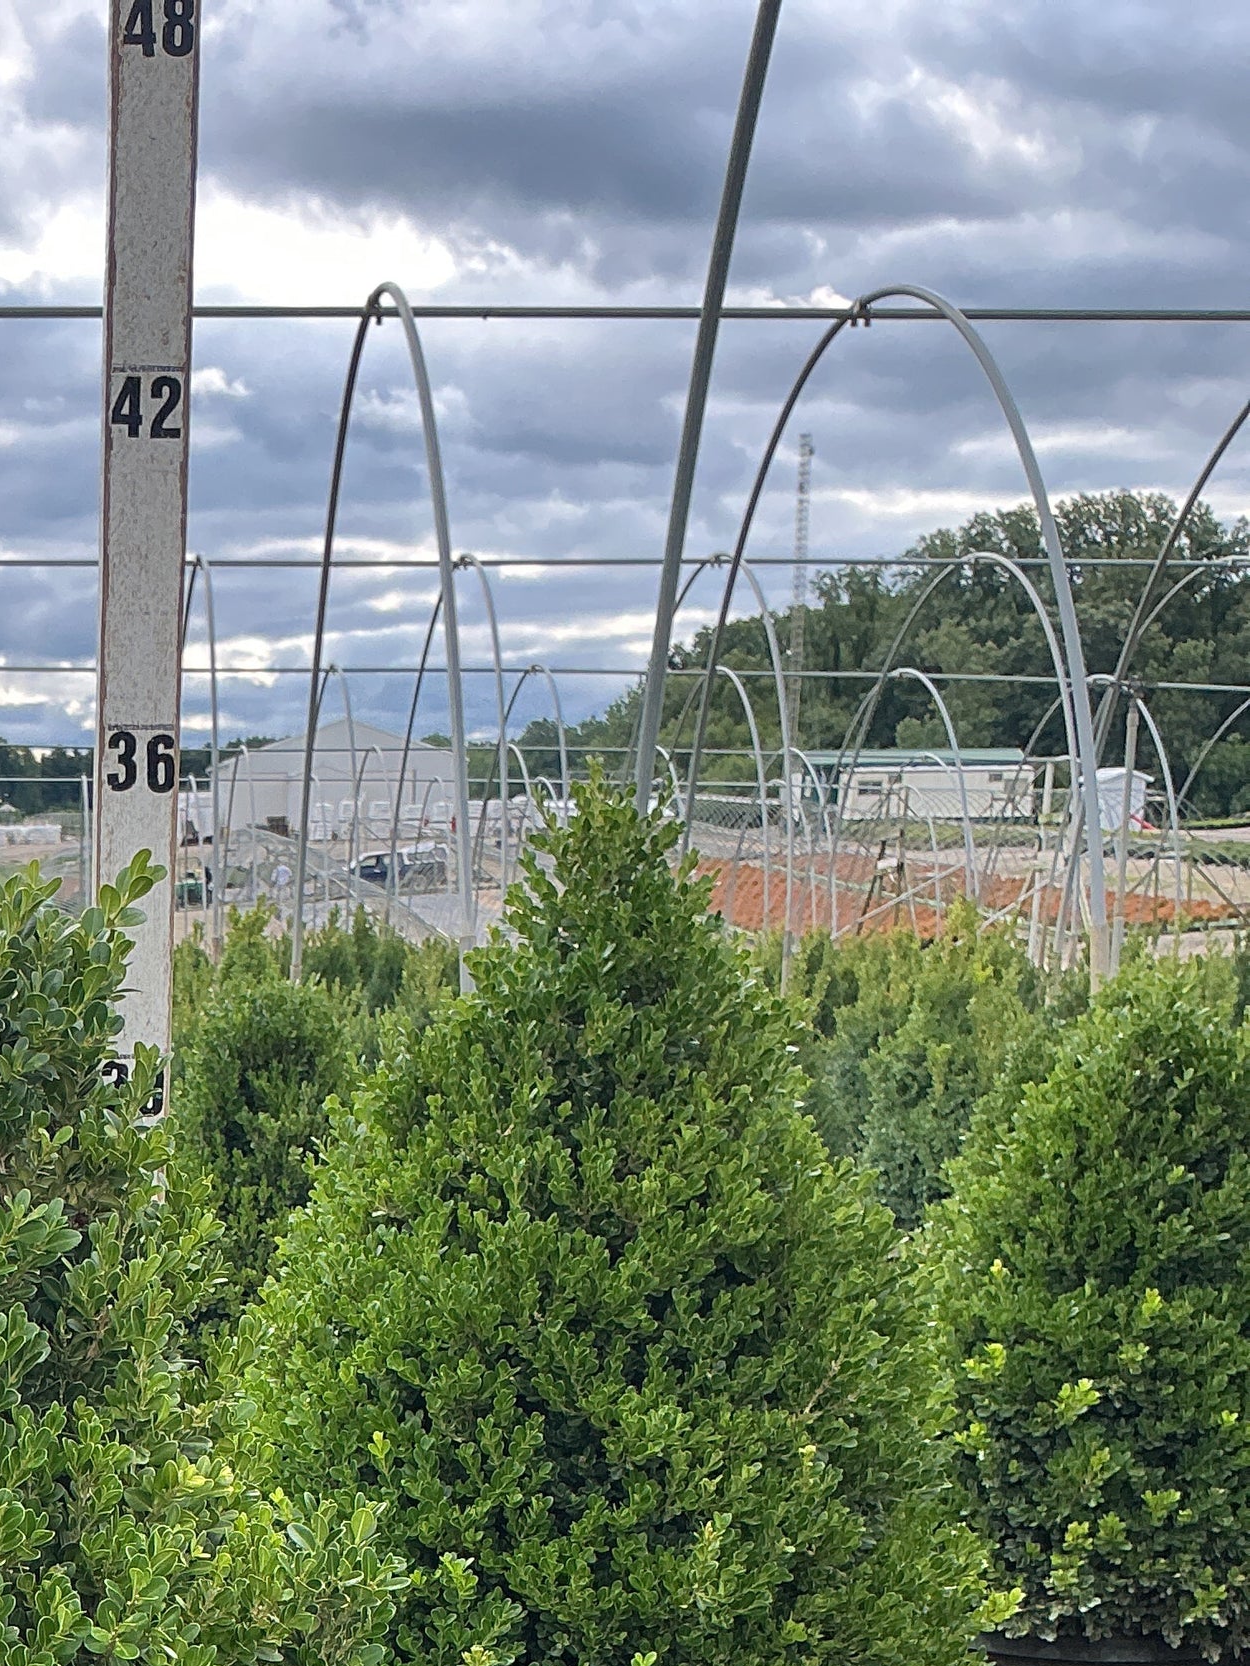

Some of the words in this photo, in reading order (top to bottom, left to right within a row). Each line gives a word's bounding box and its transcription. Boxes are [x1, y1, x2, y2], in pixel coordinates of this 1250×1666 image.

[124, 0, 194, 57] 48
[112, 376, 181, 438] 42
[107, 731, 174, 793] 36
